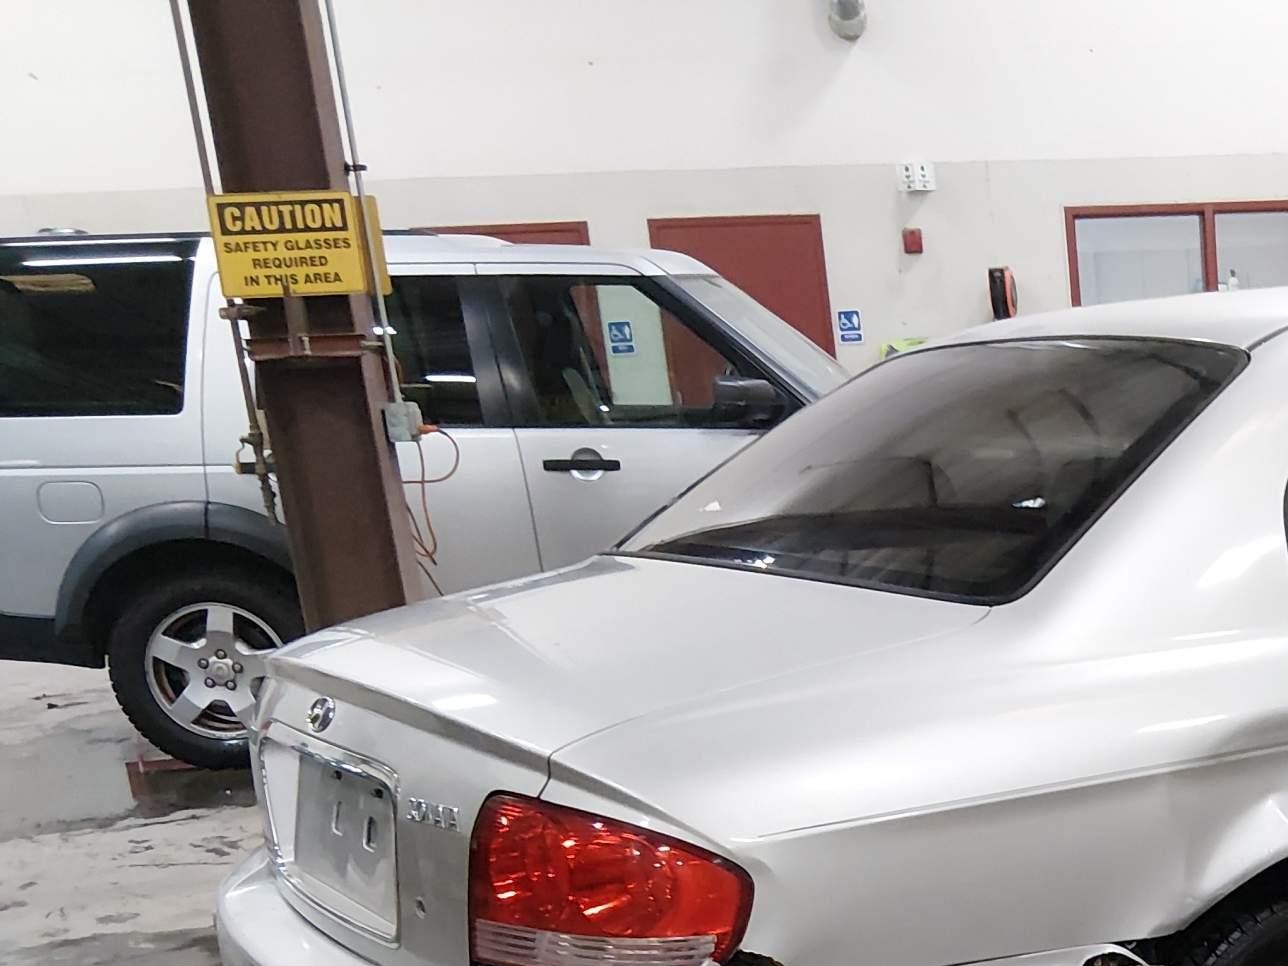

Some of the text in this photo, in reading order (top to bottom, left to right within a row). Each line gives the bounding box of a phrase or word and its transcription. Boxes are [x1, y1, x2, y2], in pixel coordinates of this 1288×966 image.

[224, 203, 343, 232] CAUTION
[224, 238, 351, 253] SAFETY GLASSES
[252, 255, 329, 269] REQUIRED
[244, 271, 343, 286] IN THIS AREA
